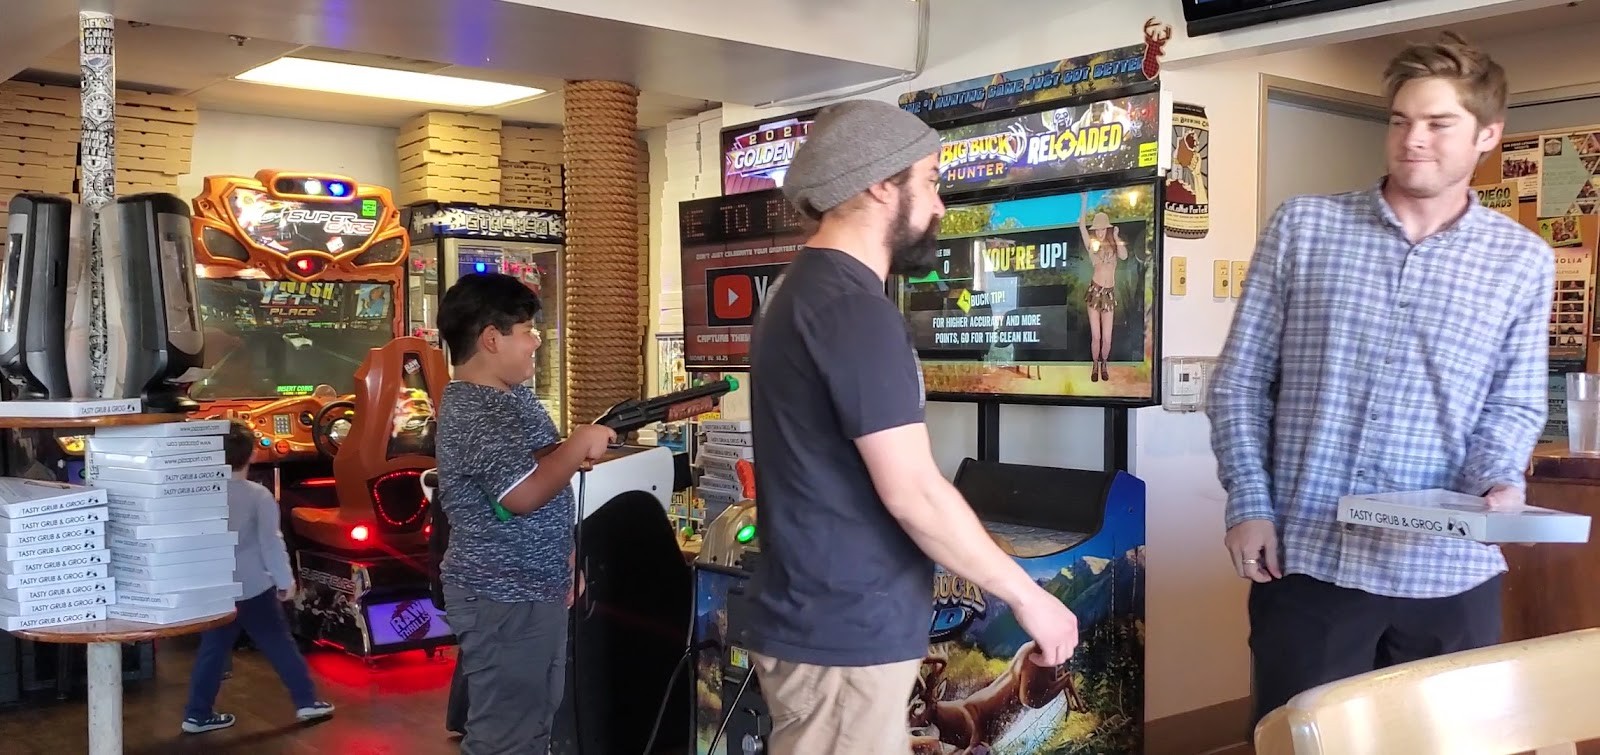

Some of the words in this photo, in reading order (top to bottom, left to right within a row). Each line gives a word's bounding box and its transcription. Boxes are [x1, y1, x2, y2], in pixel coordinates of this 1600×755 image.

[935, 88, 985, 108] HUNTING
[988, 80, 1024, 98] GAME
[1026, 72, 1060, 90] JUST
[1063, 66, 1090, 84] GOT
[749, 124, 808, 145] 2021
[1027, 123, 1123, 164] RELOADED
[734, 141, 795, 169] GOLDEN
[940, 142, 968, 163] BIG
[969, 132, 1012, 156] BUCK
[948, 163, 1004, 182] HUNTER
[1478, 187, 1510, 200] DIEGO
[287, 210, 358, 223] SUPER
[324, 220, 376, 234] CARS
[466, 213, 549, 235] STACKER
[983, 245, 1036, 272] YOU'RE
[1040, 242, 1067, 268] UP!
[971, 294, 990, 306] BUCK
[991, 291, 1006, 304] TIP!
[933, 318, 944, 328] FOR
[946, 317, 968, 328] HIGHER
[970, 316, 1004, 327] ACCURACY
[1006, 315, 1020, 326] AND
[1022, 314, 1041, 326] MORE
[936, 332, 959, 344] POINTS,
[961, 332, 968, 343] GO
[971, 332, 984, 343] FOR
[985, 332, 998, 343] THE
[1000, 332, 1020, 343] CLEAN
[1023, 331, 1040, 343] KILL.
[65, 516, 85, 524] GROG
[1350, 509, 1372, 521] TASTY
[1375, 513, 1400, 526] GRUB
[1402, 518, 1409, 527] &
[1411, 519, 1442, 531] GROG
[62, 530, 82, 538] GROG
[391, 600, 426, 632] RAW
[400, 613, 432, 640] THRILLS
